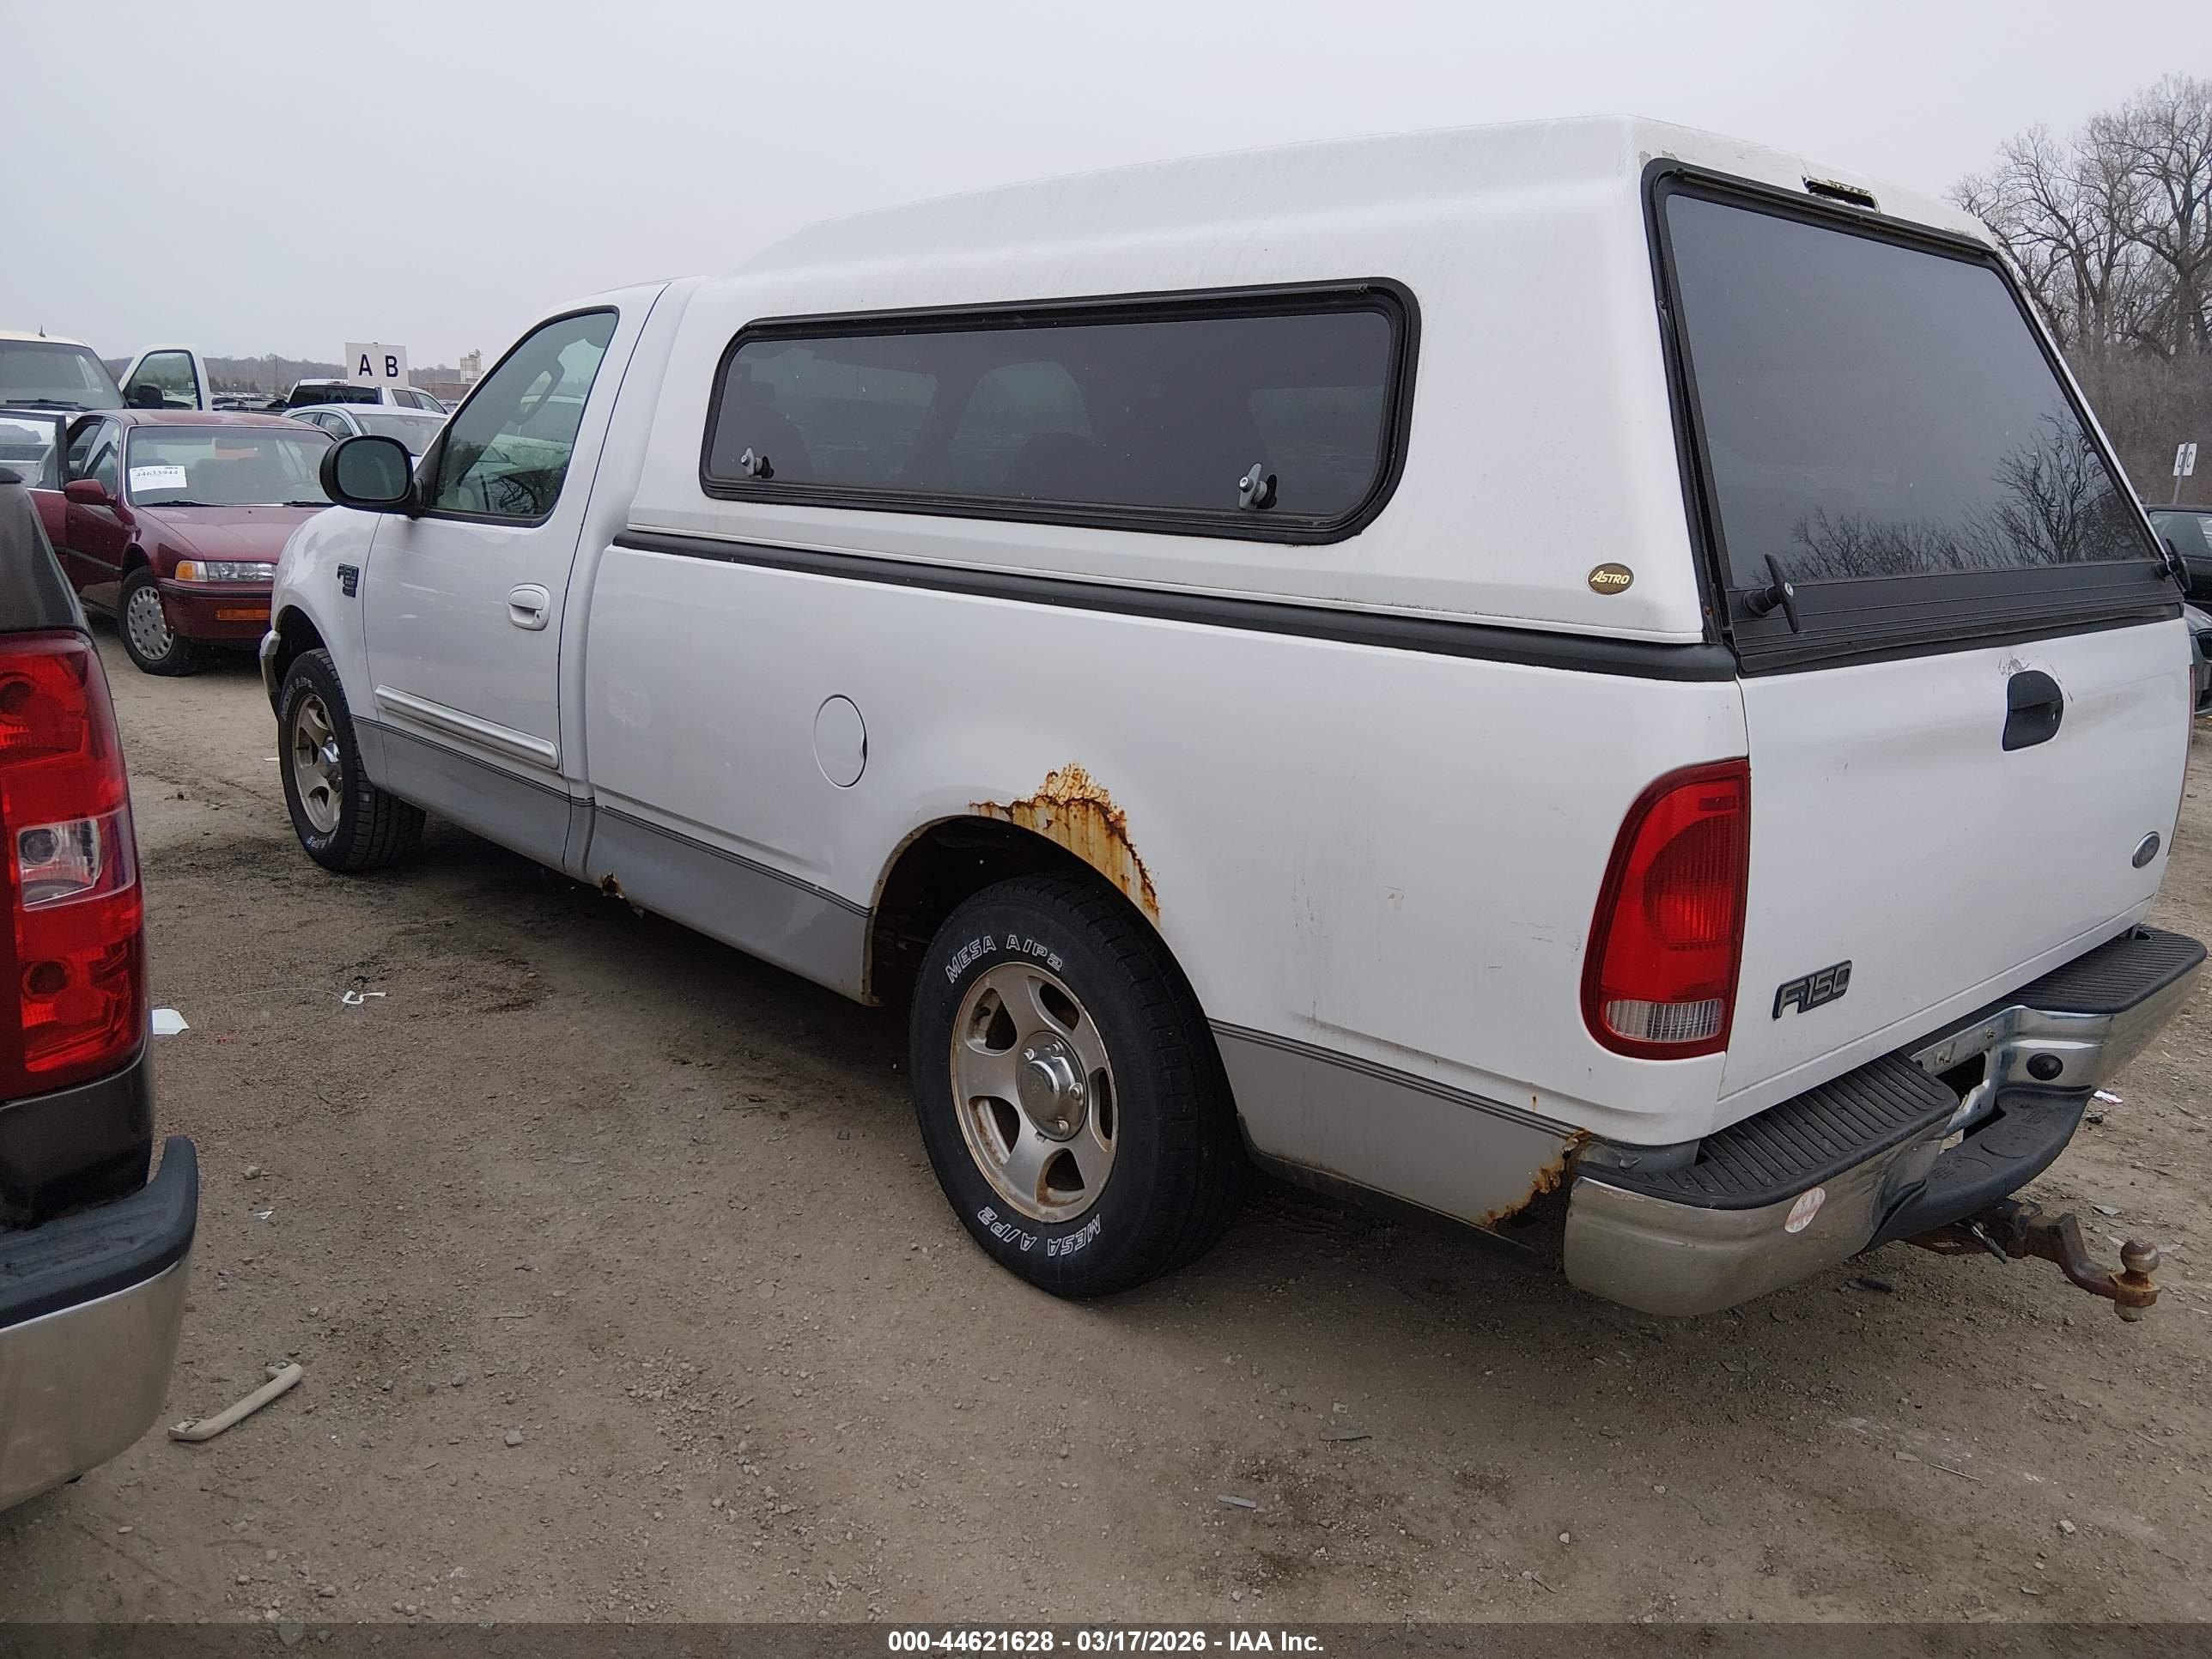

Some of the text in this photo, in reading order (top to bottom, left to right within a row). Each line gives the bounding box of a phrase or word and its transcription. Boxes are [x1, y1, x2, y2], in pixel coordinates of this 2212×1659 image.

[358, 353, 398, 378] A B
[945, 934, 997, 984] MESA
[1047, 1213, 1101, 1257] MESA
